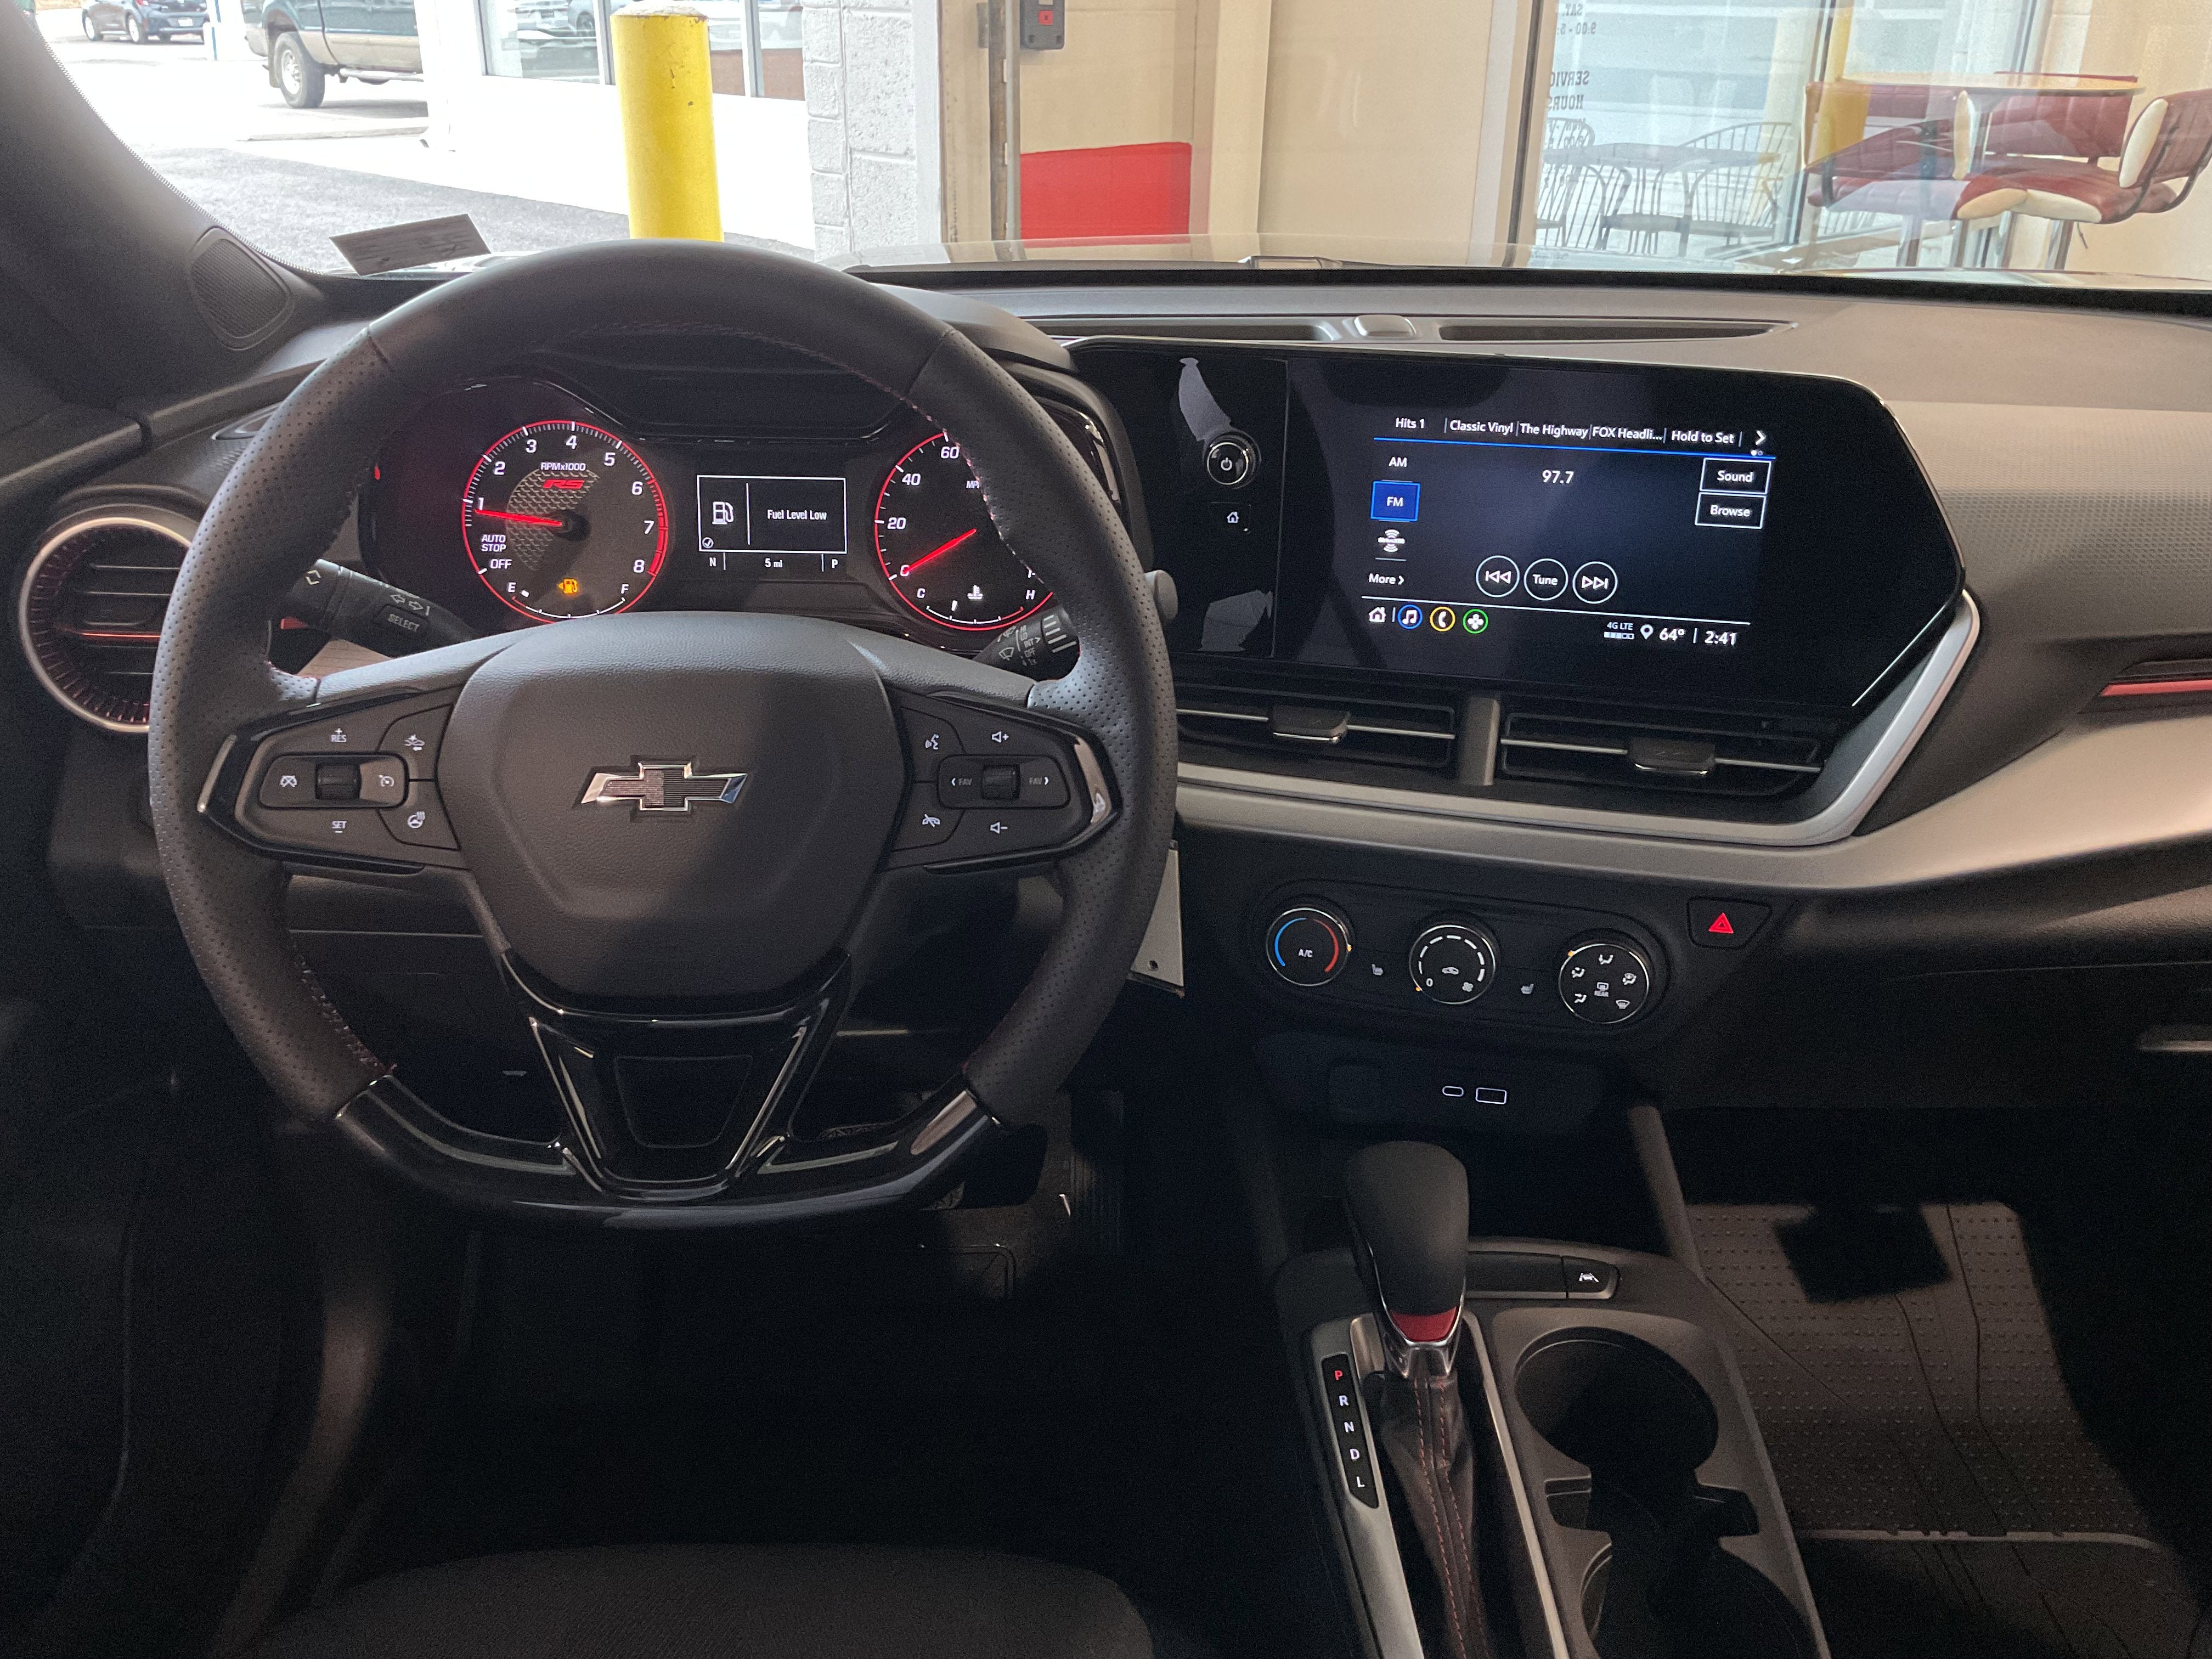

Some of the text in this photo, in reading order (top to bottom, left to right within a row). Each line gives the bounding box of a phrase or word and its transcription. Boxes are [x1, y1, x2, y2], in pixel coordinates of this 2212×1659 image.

[1395, 417, 1425, 428] Hits 1
[1449, 420, 1514, 436] Classic Vinyl
[1520, 423, 1588, 441] The Highway
[1592, 426, 1616, 438] FOX
[1671, 430, 1735, 444] Hold to Set
[525, 439, 537, 453] 3
[566, 436, 577, 449] 4
[940, 445, 960, 459] 60
[603, 452, 616, 466] 5
[1388, 456, 1407, 467] AM
[493, 461, 506, 475] 2
[540, 462, 586, 471] RPMx1000
[902, 473, 921, 486] 40
[1542, 470, 1574, 484] 97.7
[1717, 470, 1753, 483] Sound
[543, 479, 585, 489] RS
[631, 481, 643, 495] 6
[478, 497, 484, 510] 1
[1386, 496, 1403, 507] FM
[767, 509, 827, 520] Fuel Level Low
[1710, 505, 1750, 518] Browse
[644, 520, 654, 534] 7
[887, 517, 907, 530] 20
[482, 534, 506, 543] AUTO
[481, 543, 506, 552] STOP
[490, 558, 513, 569] OFF
[633, 560, 645, 573] 8
[709, 557, 716, 567] N
[765, 558, 783, 568] 5 mi
[831, 558, 838, 569] P
[900, 565, 910, 577] 0
[1368, 573, 1396, 585] More
[1532, 574, 1558, 586] Tune
[508, 582, 516, 592] E
[620, 584, 629, 594] F
[917, 588, 926, 599] C
[1025, 589, 1035, 600] H
[388, 613, 420, 631] SELECT
[1704, 630, 1737, 645] 2:41
[331, 734, 347, 743] RES
[958, 777, 972, 786] FAV
[331, 821, 347, 830] SET
[1298, 949, 1313, 958] A/C
[1335, 1370, 1343, 1381] P
[1339, 1395, 1349, 1407] R
[1344, 1421, 1355, 1433] N
[1350, 1448, 1360, 1460] D
[1356, 1476, 1365, 1488] L
